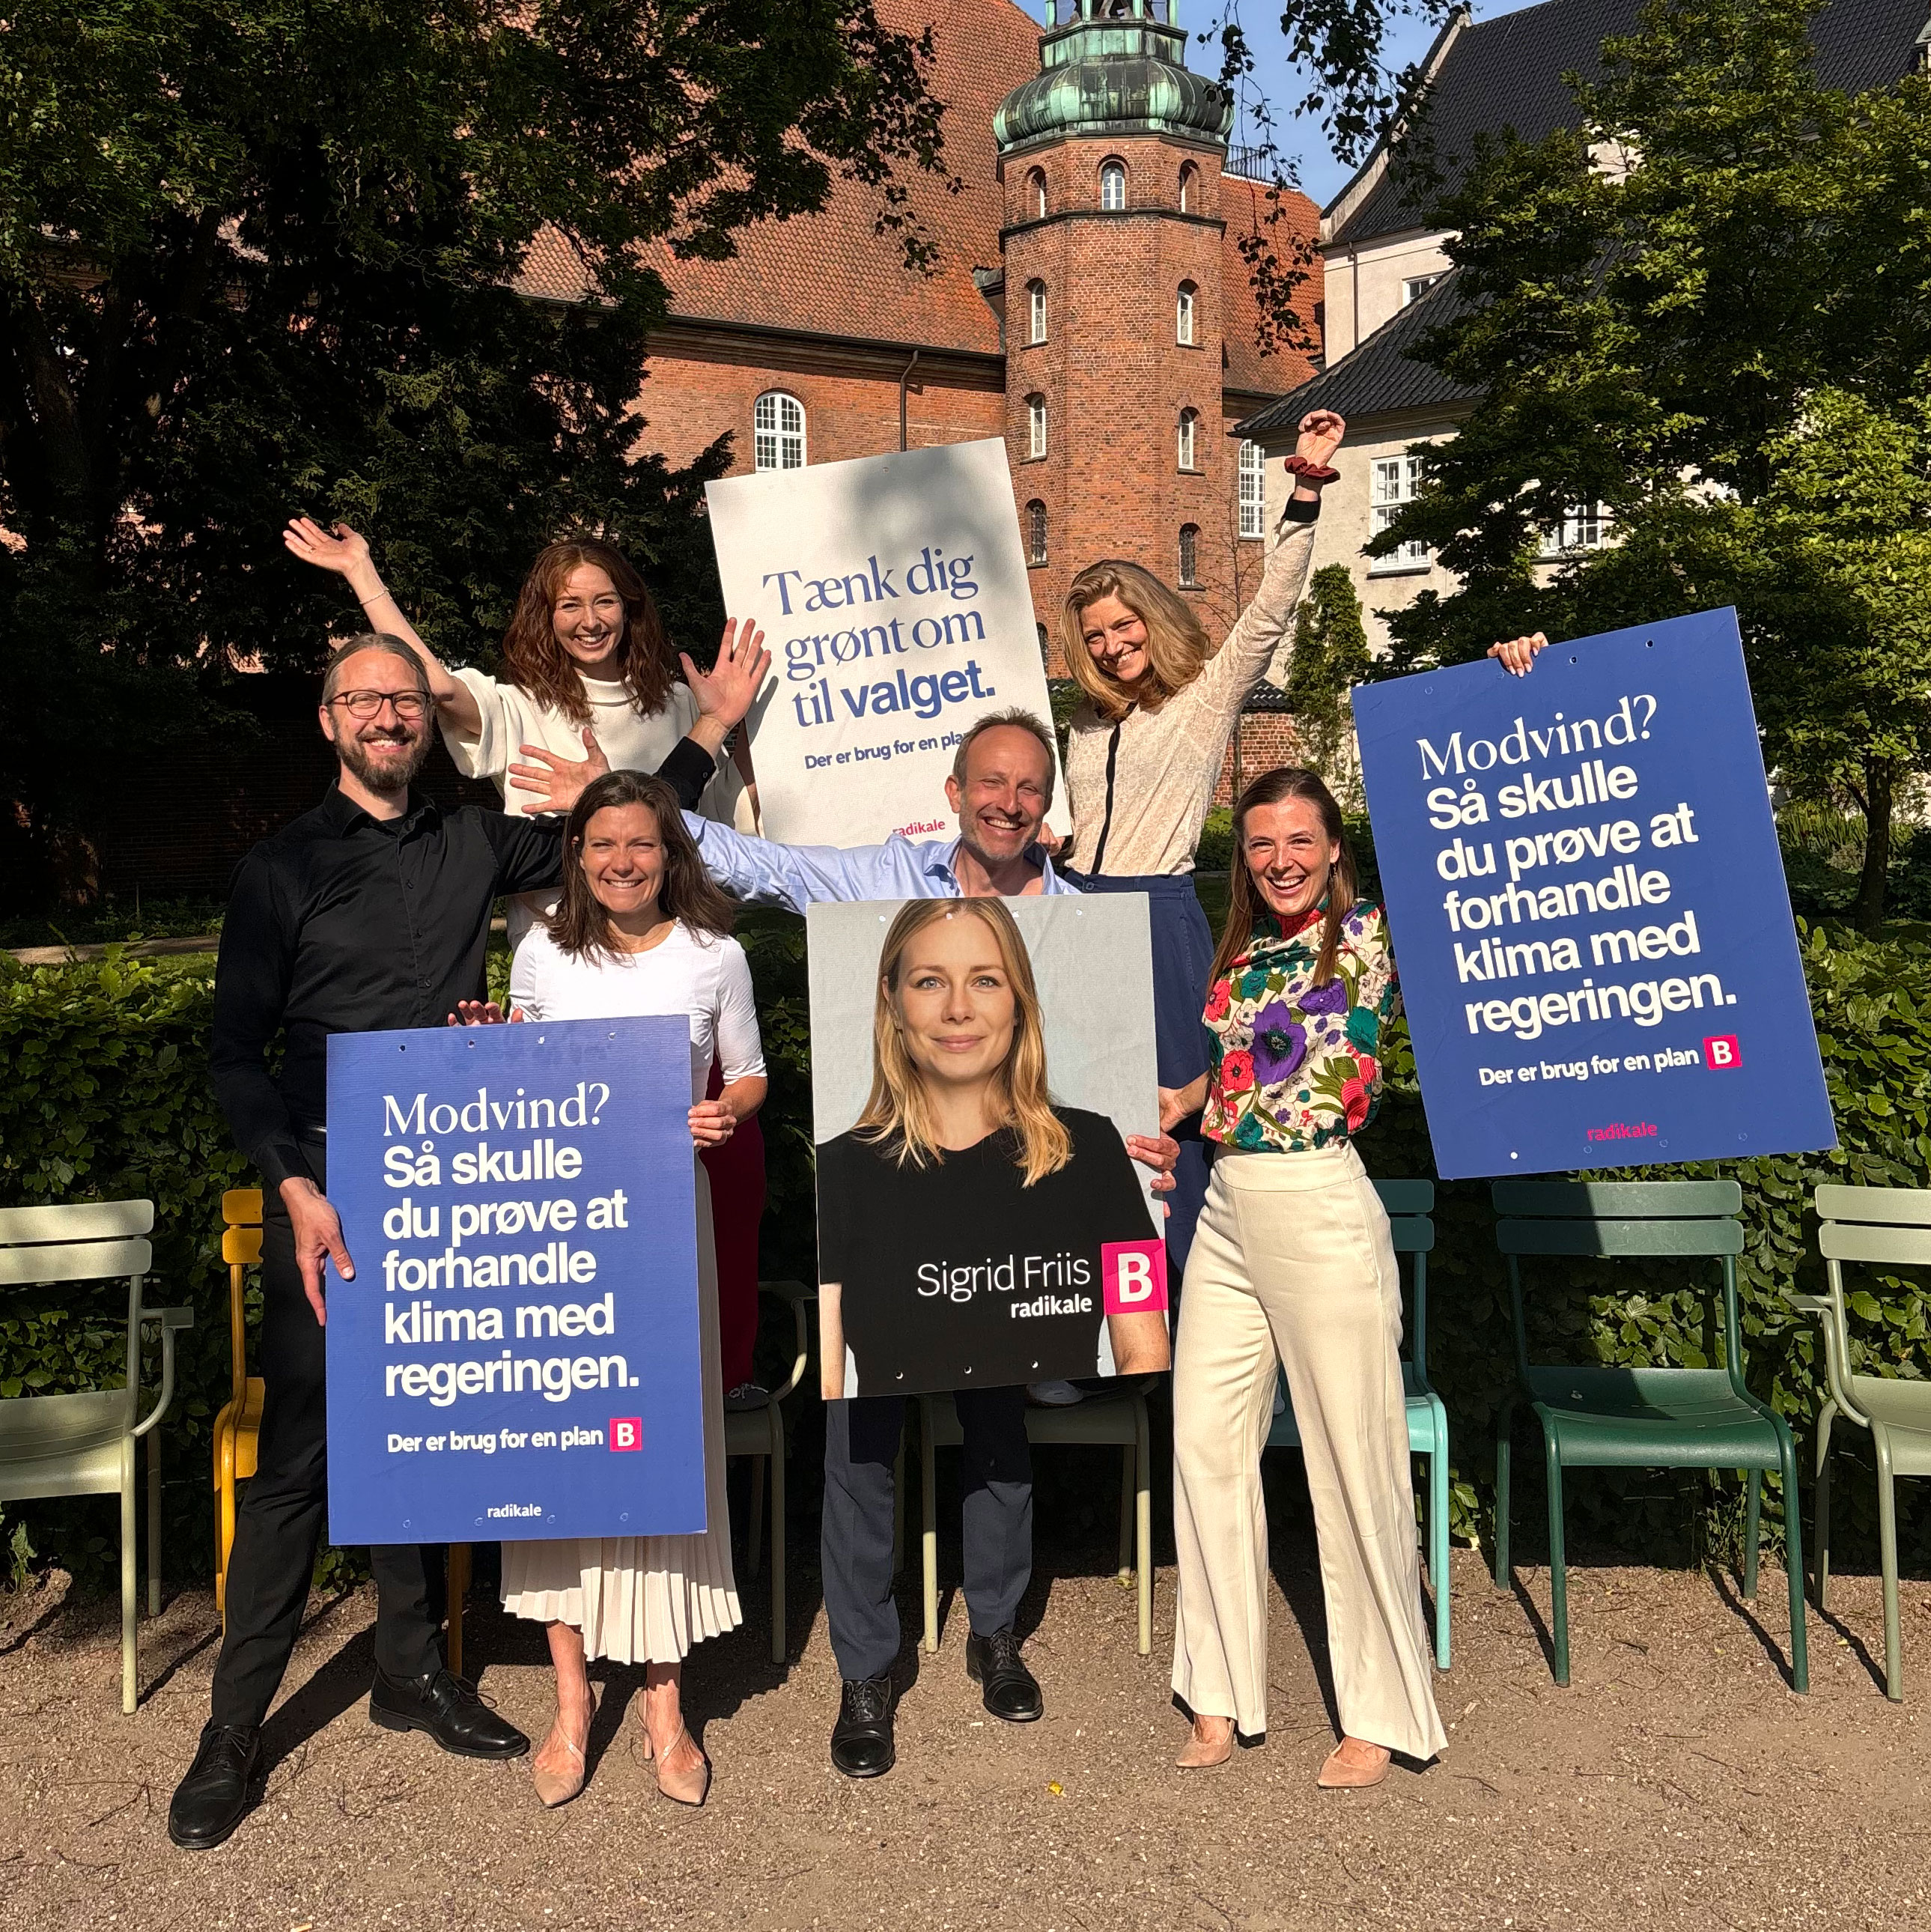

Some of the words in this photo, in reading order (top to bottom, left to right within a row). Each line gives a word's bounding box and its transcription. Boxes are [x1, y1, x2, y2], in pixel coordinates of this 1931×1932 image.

[762, 554, 901, 616] Tænk
[906, 546, 979, 600] dig
[785, 617, 909, 681] grønt
[912, 610, 986, 648] om
[791, 677, 835, 727] til
[840, 660, 996, 719] valget.
[805, 755, 832, 770] Der
[836, 751, 851, 764] er
[854, 745, 891, 761] brug
[893, 740, 915, 754] for
[918, 737, 938, 750] en
[940, 731, 966, 750] pla
[1416, 694, 1657, 780] Modvind?
[1426, 778, 1490, 830] Så
[1497, 759, 1638, 818] skulle
[1436, 837, 1497, 881] du
[1504, 820, 1641, 882] prøve
[1649, 802, 1700, 848] at
[1443, 863, 1671, 932] forhandle
[1453, 937, 1583, 983] klima
[1590, 910, 1701, 966] med
[1465, 973, 1737, 1040] regeringen.
[1478, 1068, 1514, 1086] Der
[1517, 1066, 1538, 1082] er
[1539, 1060, 1589, 1081] brug
[1590, 1054, 1620, 1075] for
[1623, 1054, 1651, 1072] en
[1653, 1047, 1700, 1073] plan
[1712, 1040, 1733, 1065] B
[382, 1081, 610, 1137] Modvind?
[1587, 1121, 1658, 1141] radikale
[383, 1140, 442, 1188] Så
[451, 1137, 583, 1185] skulle
[383, 1197, 440, 1240] du
[451, 1199, 577, 1248] prøve
[586, 1188, 629, 1230] at
[382, 1241, 597, 1292] forhandle
[917, 1254, 1015, 1302] Sigrid
[1024, 1252, 1091, 1289] Friis
[1117, 1252, 1153, 1303] B
[385, 1300, 505, 1344] klima
[515, 1292, 615, 1338] med
[1011, 1293, 1092, 1319] radikale
[386, 1349, 639, 1407] regeringen.
[387, 1433, 423, 1453] Der
[425, 1436, 447, 1451] er
[449, 1430, 496, 1454] brug
[499, 1428, 529, 1449] for
[531, 1431, 557, 1448] en
[561, 1425, 604, 1451] plan
[617, 1423, 635, 1447] B
[487, 1503, 542, 1518] radikale
